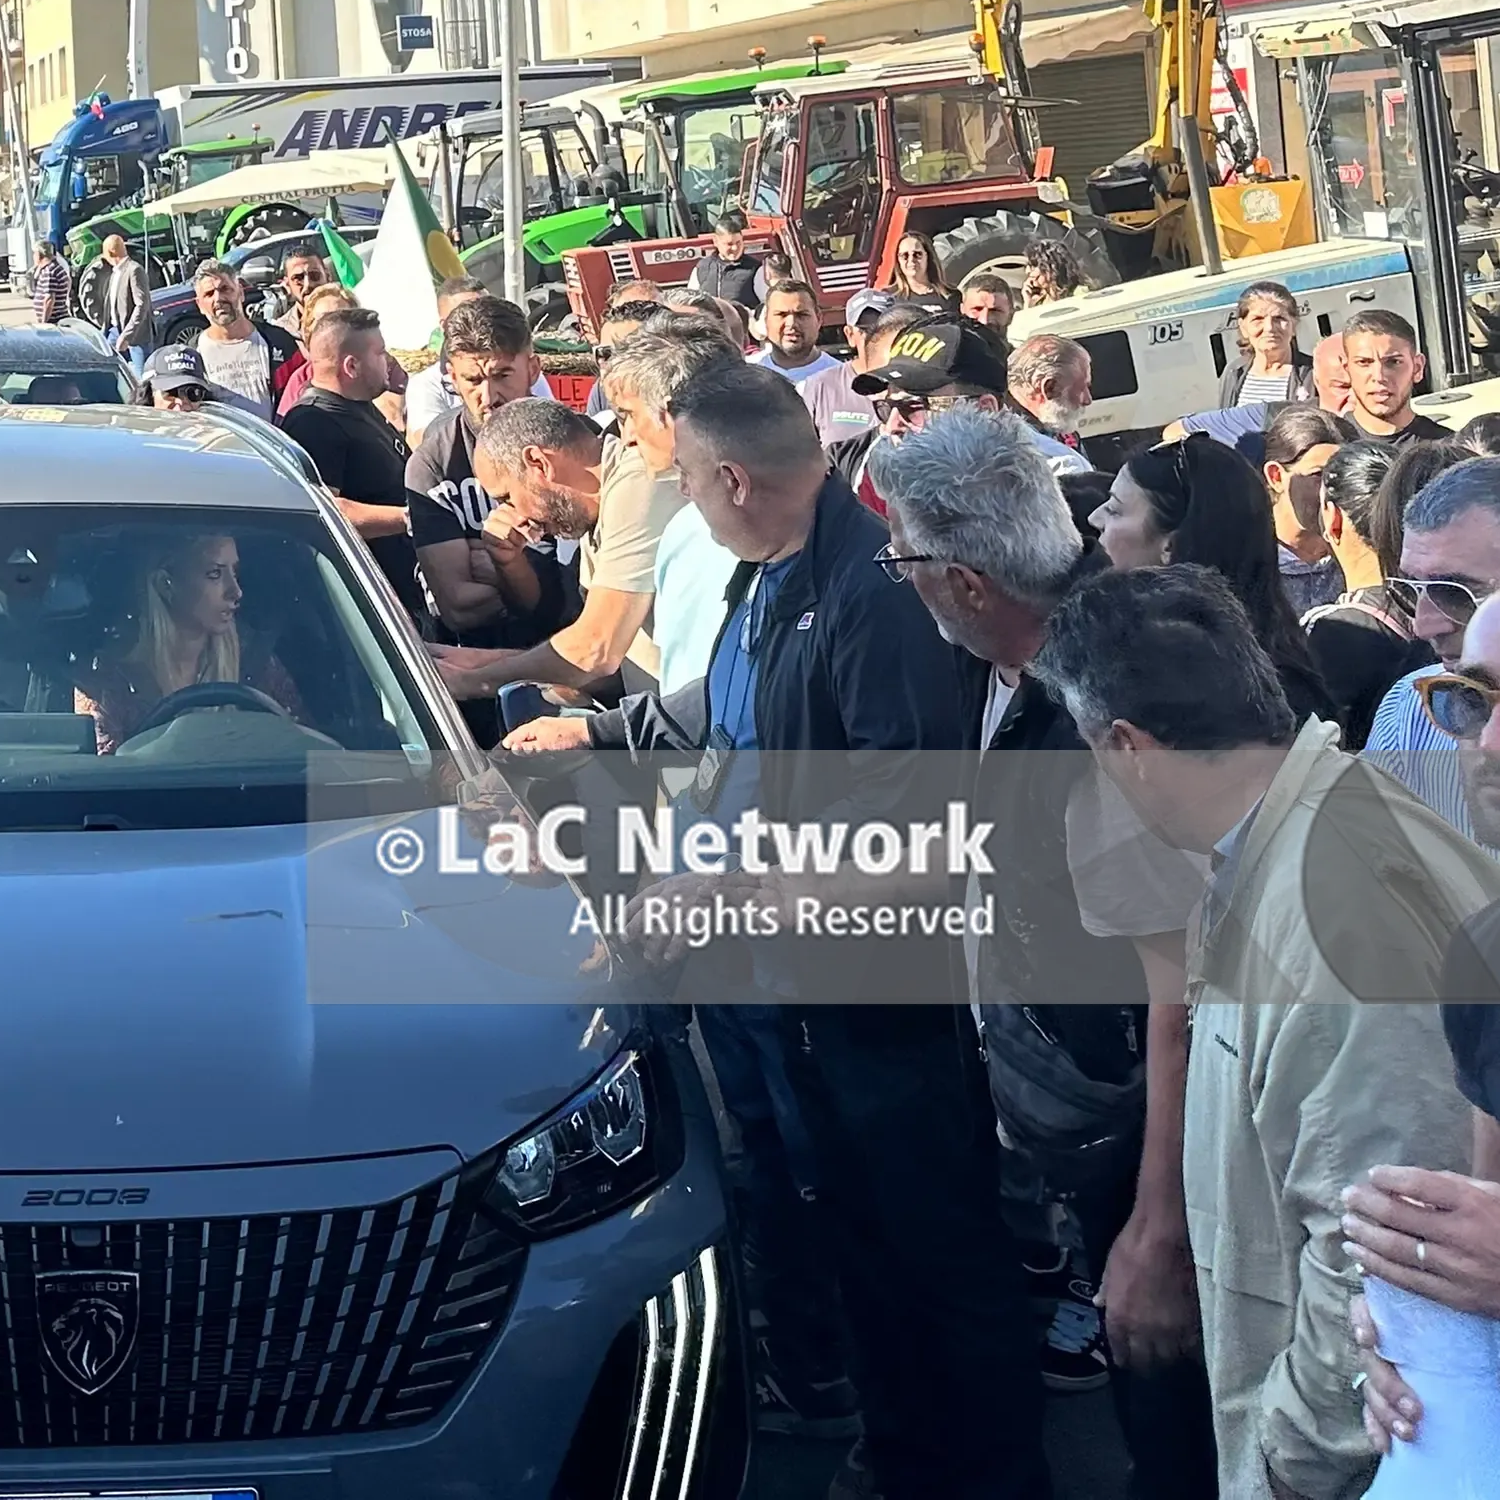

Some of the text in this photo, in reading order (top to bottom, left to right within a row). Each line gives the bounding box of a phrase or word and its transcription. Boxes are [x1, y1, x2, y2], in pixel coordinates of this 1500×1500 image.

[402, 28, 432, 37] STOSA
[241, 184, 356, 204] CENTRAL FRUTTA
[654, 248, 696, 263] 80-90
[1148, 320, 1184, 345] 105
[164, 352, 197, 364] POLIZIA
[167, 362, 195, 371] LOCALE
[21, 1187, 151, 1207] 2008
[44, 1281, 131, 1297] PEUGEOT
